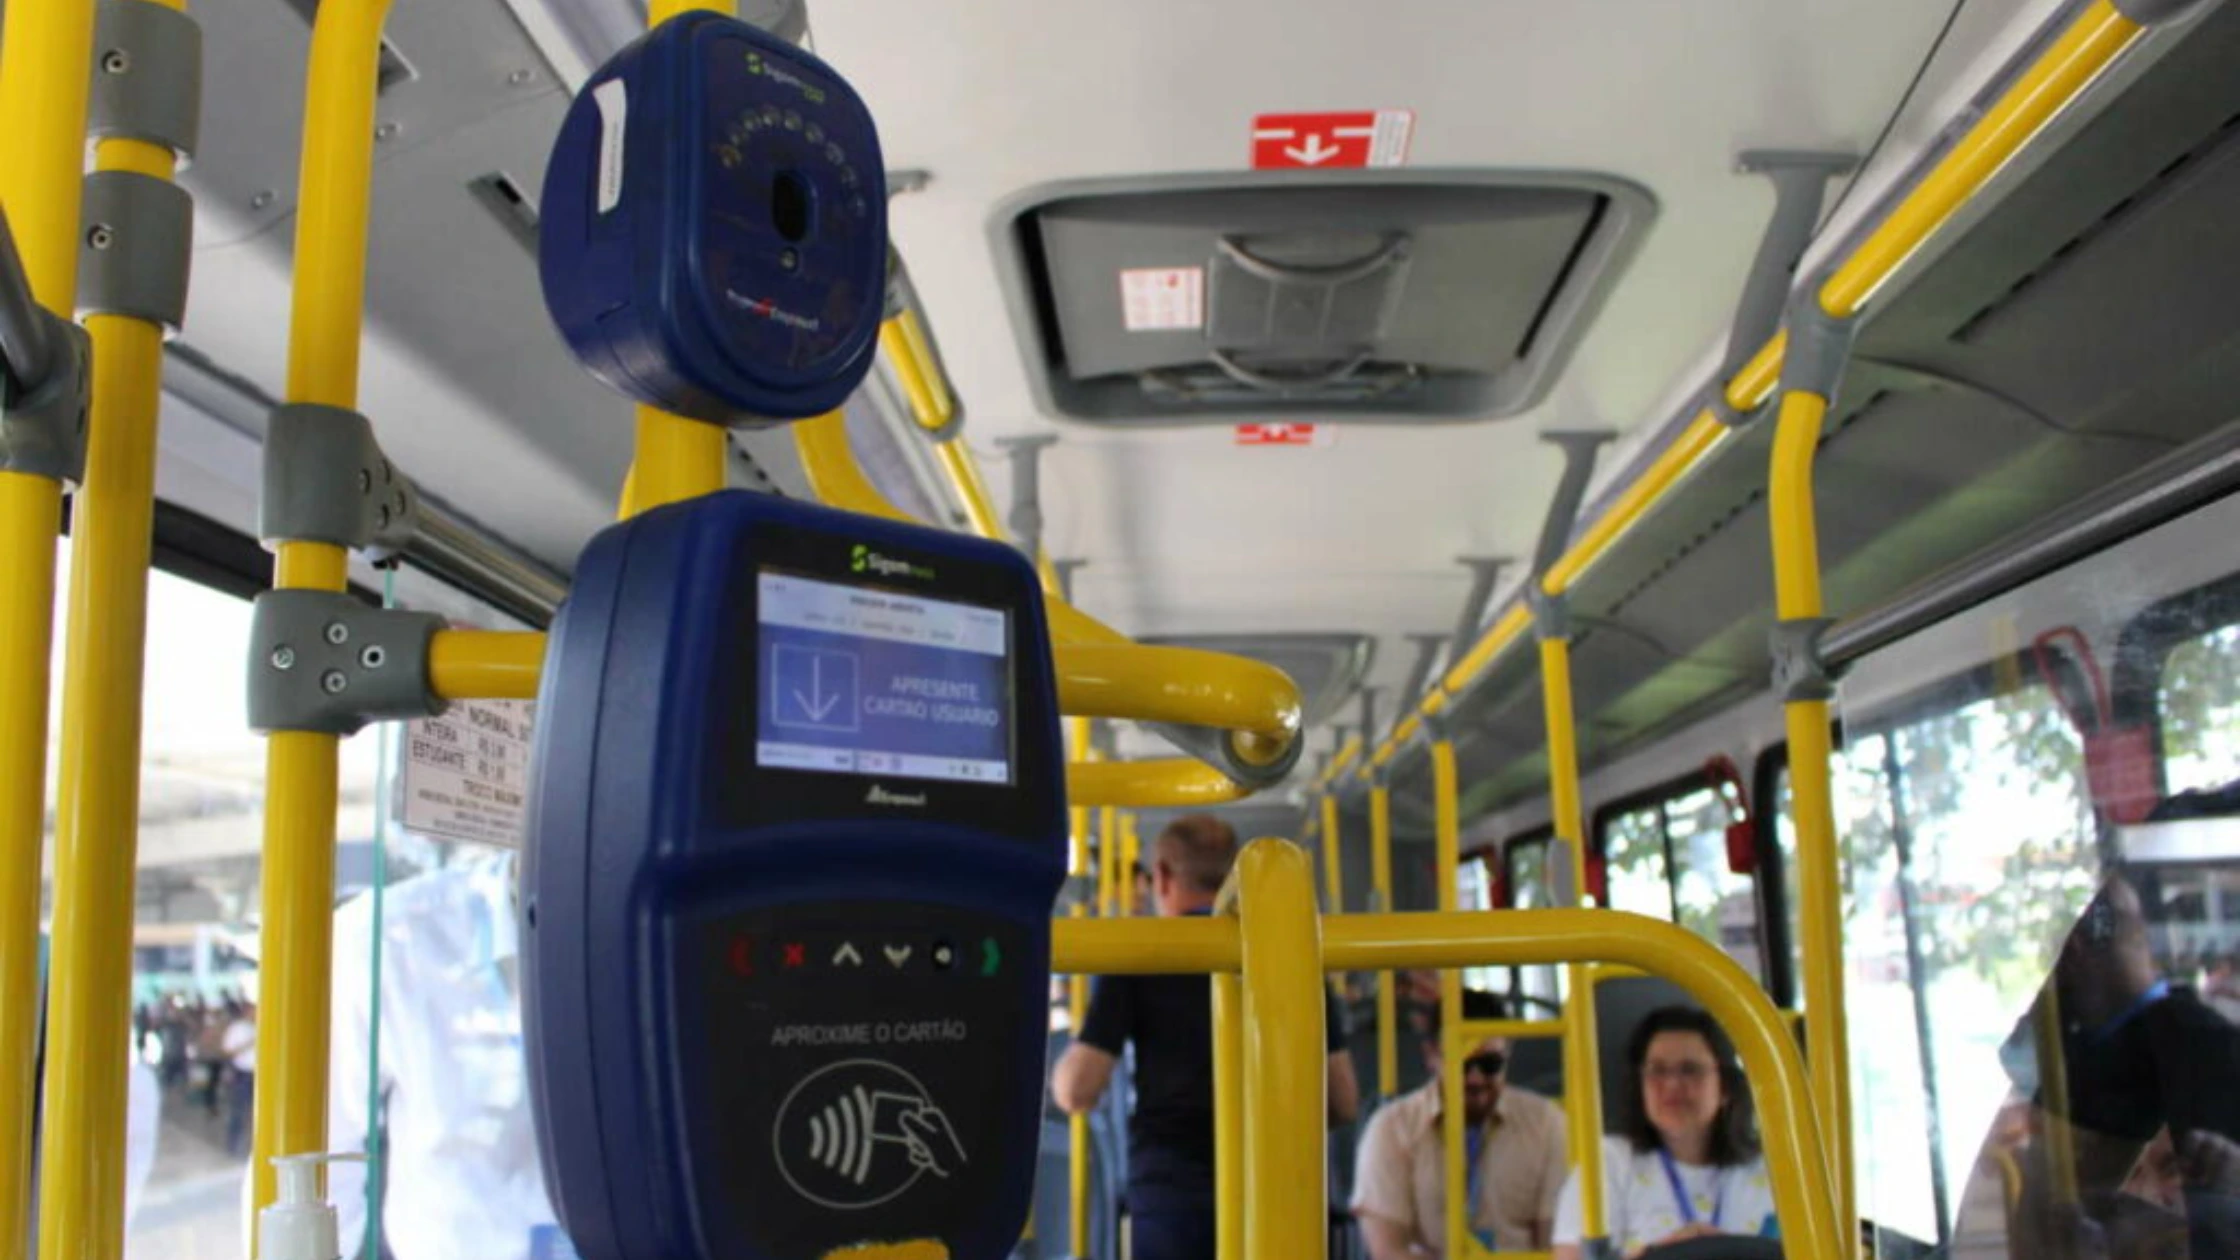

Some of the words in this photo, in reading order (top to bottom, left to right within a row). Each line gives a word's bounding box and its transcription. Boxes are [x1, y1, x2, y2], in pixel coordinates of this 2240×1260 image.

[892, 677, 979, 702] APRESENTE
[412, 739, 465, 771] ESTUDANTE
[771, 1023, 871, 1046] APROXIME
[875, 1022, 891, 1043] O
[894, 1017, 967, 1042] CARTÃO
